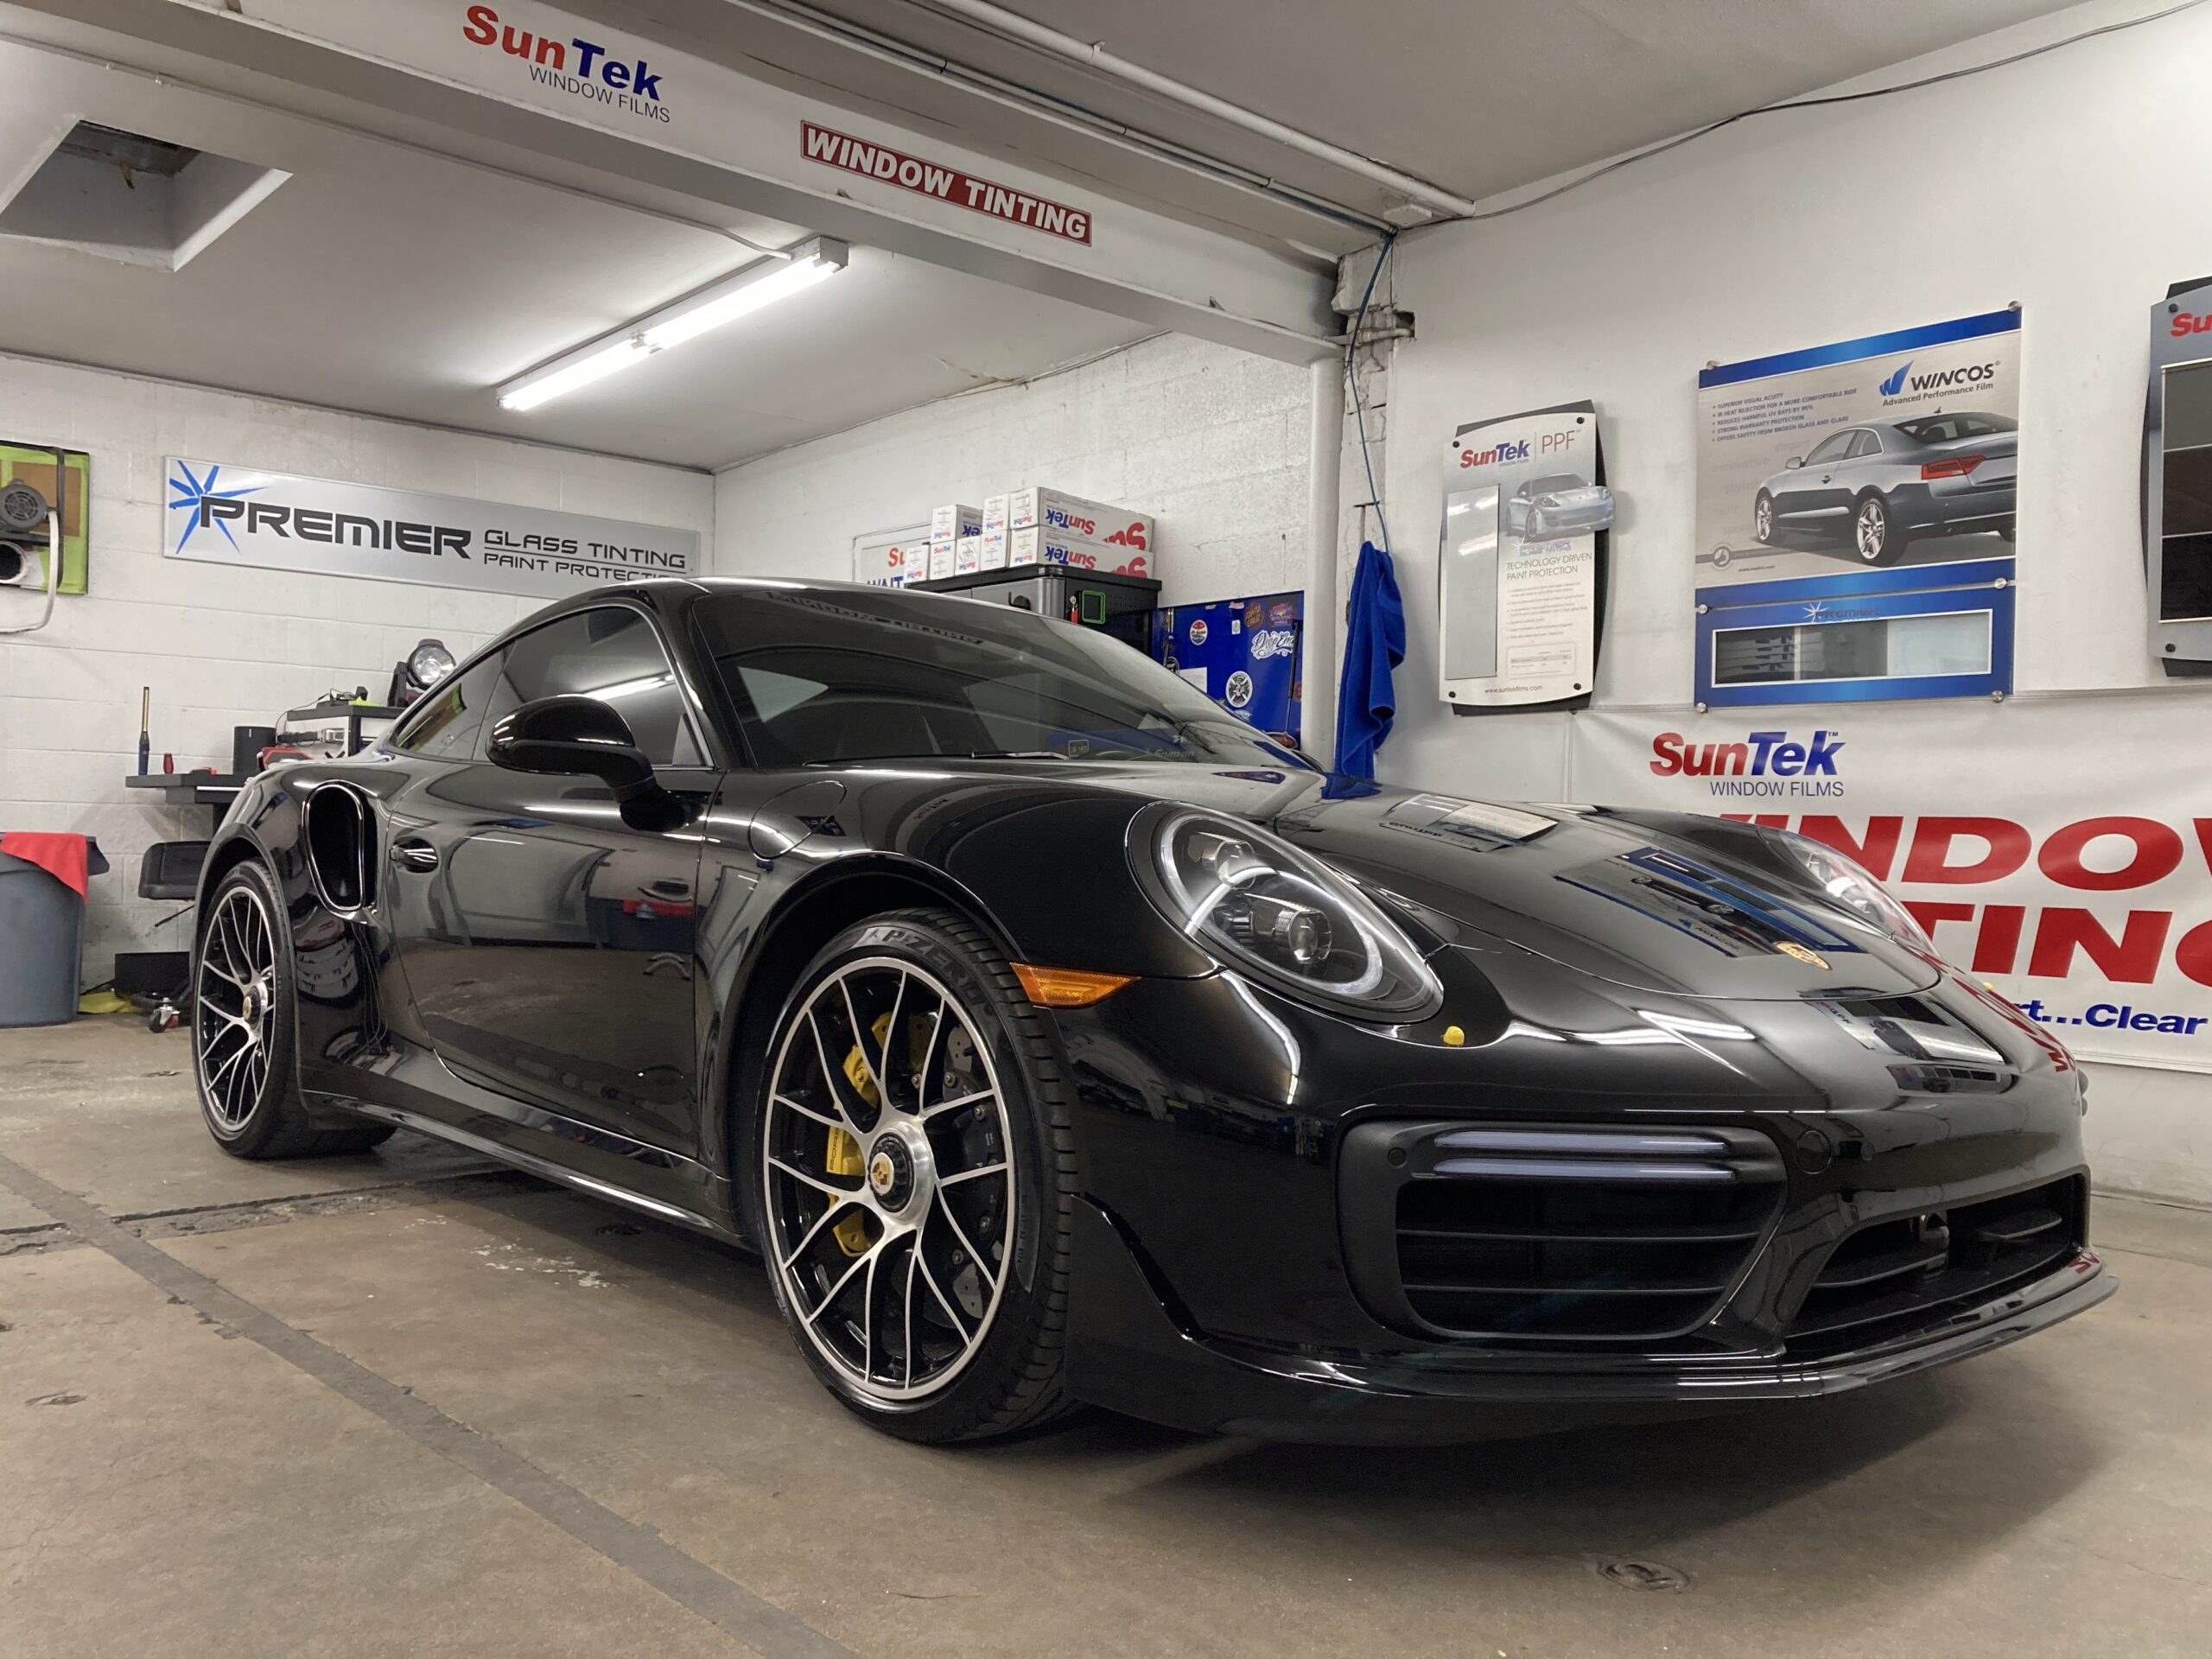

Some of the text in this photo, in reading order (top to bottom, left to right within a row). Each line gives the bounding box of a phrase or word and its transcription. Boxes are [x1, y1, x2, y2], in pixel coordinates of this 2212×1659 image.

[463, 5, 664, 101] SunTek
[530, 65, 671, 123] WINDOW FILMS
[807, 128, 1087, 239] WINDOW TINTING
[1910, 364, 1994, 391] WINCOS
[1717, 392, 1784, 410] SUPERIOR VISUAL ACUITY
[1738, 404, 1766, 414] REJECTION
[1802, 390, 1842, 403] COMFORTABLE
[1883, 383, 1993, 406] Advanced Performance Film
[1770, 415, 1805, 425] PROTECTION
[1541, 430, 1575, 454] PPF
[1737, 430, 1757, 439] SAFETY
[1460, 440, 1531, 468] SunTek
[200, 496, 473, 560] PREMIER
[1045, 509, 1096, 535] SunTek
[485, 529, 686, 569] GLASS TINTING
[1044, 546, 1096, 570] SunTek
[1507, 553, 1592, 570] TECHNOLOGY DRIVEN
[484, 553, 674, 582] PAINT PROTECT
[1507, 565, 1578, 581] PAINT PROTECTION
[1649, 731, 1847, 776] SunTek
[1710, 781, 1844, 797] WINDOW FILMS
